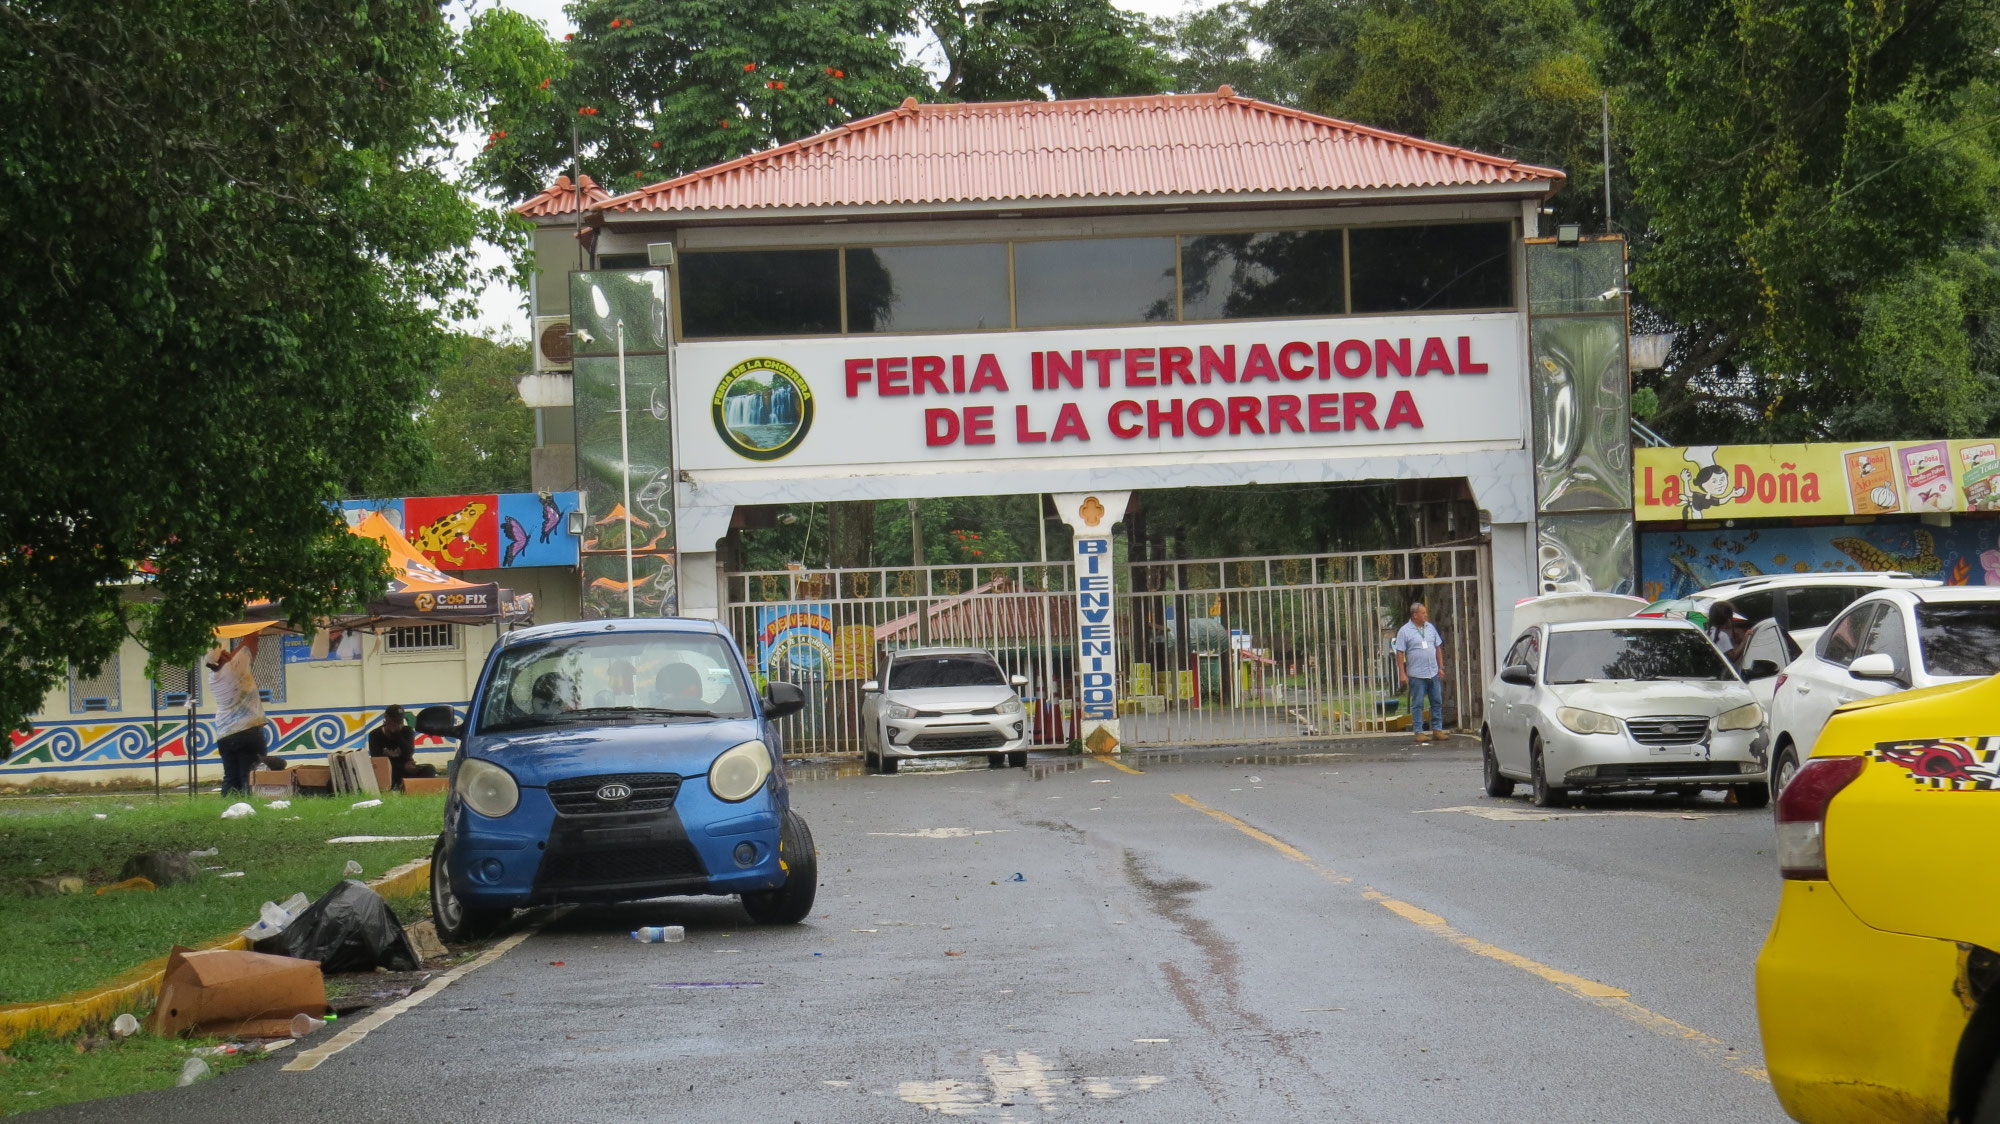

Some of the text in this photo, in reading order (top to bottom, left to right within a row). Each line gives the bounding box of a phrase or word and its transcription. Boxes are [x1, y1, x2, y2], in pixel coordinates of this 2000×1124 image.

[713, 360, 811, 405] FERIA DE LA CHORRERA
[844, 336, 1489, 397] FERIA INTERNACIONAL
[924, 390, 1424, 446] DE LA CHORRERA
[1644, 462, 1822, 506] La Doña
[1855, 479, 1872, 491] Ajo
[1078, 539, 1114, 720] BIENVENIDOS
[602, 788, 626, 798] KIA
